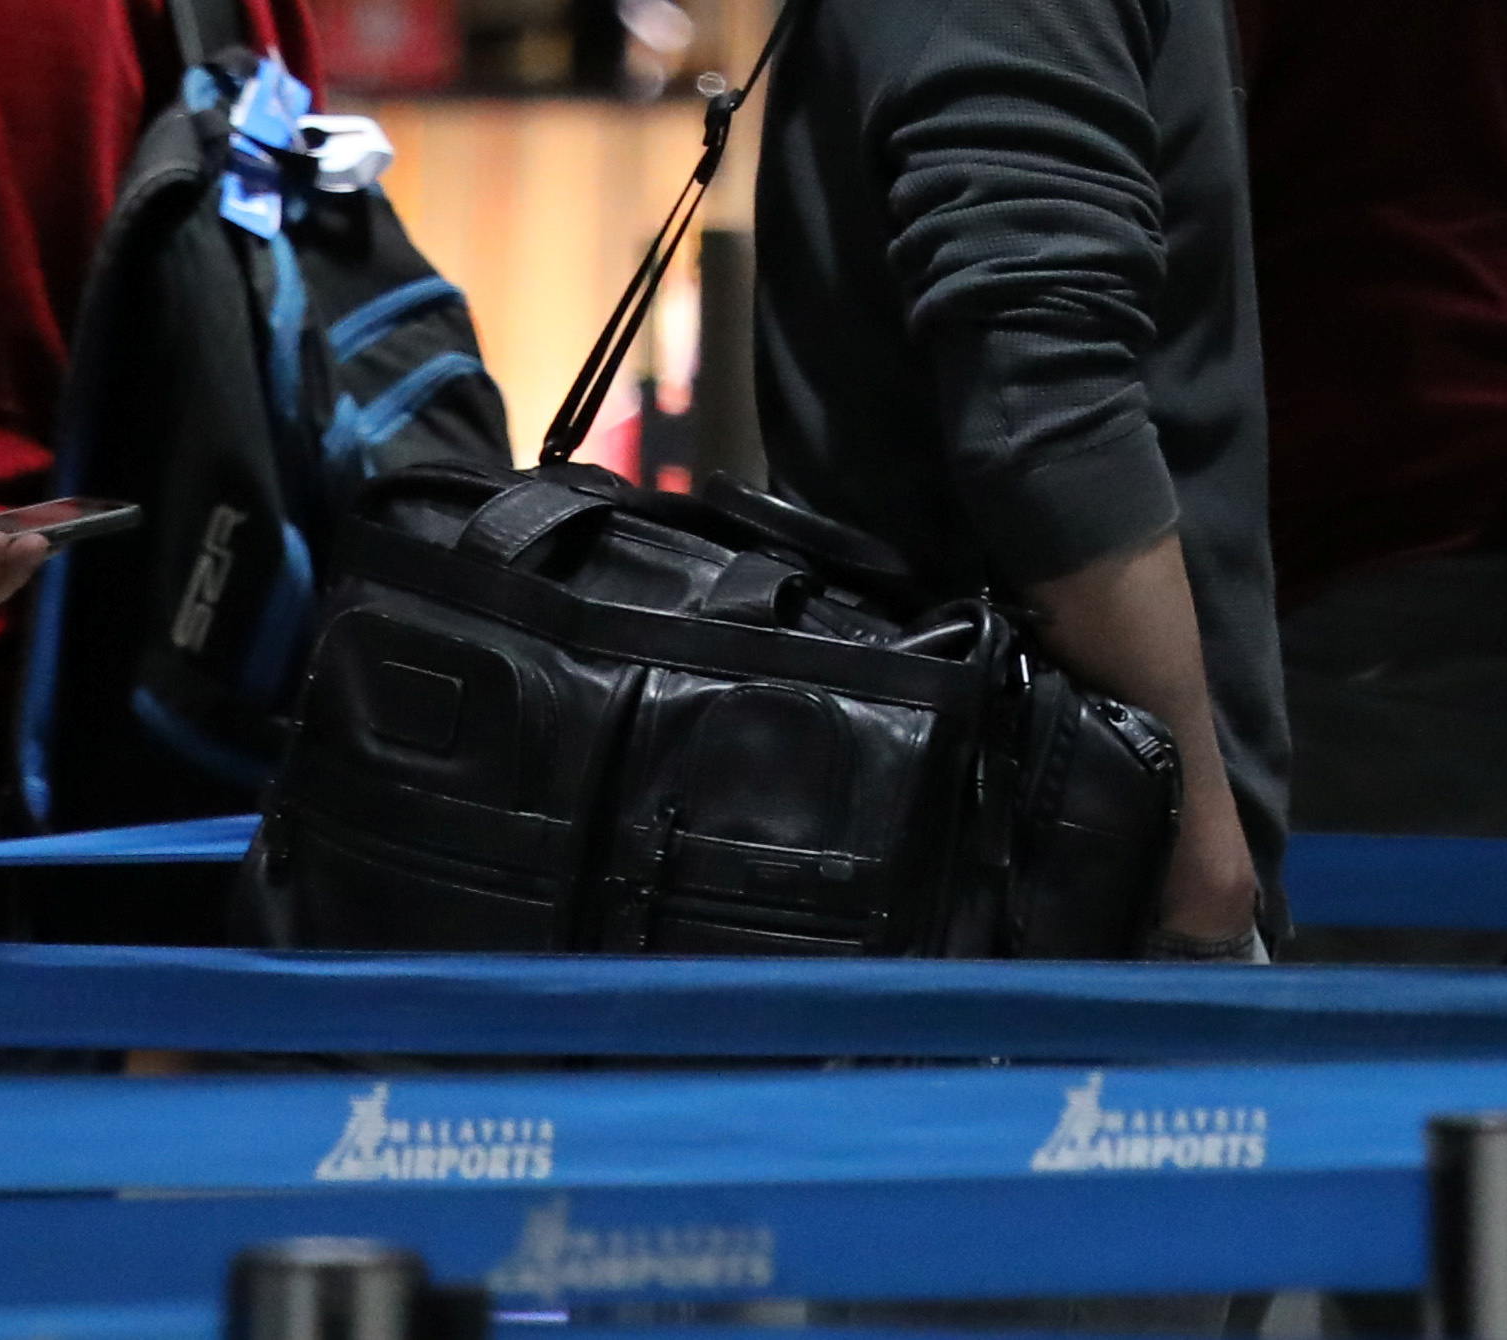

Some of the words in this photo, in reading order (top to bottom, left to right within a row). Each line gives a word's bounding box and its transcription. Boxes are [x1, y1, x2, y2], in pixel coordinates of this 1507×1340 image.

[388, 1119, 555, 1143] MALAYSIA
[1101, 1108, 1268, 1133] MALAYSIA
[381, 1144, 555, 1181] AIRPORTS
[1093, 1134, 1267, 1170] AIRPORTS
